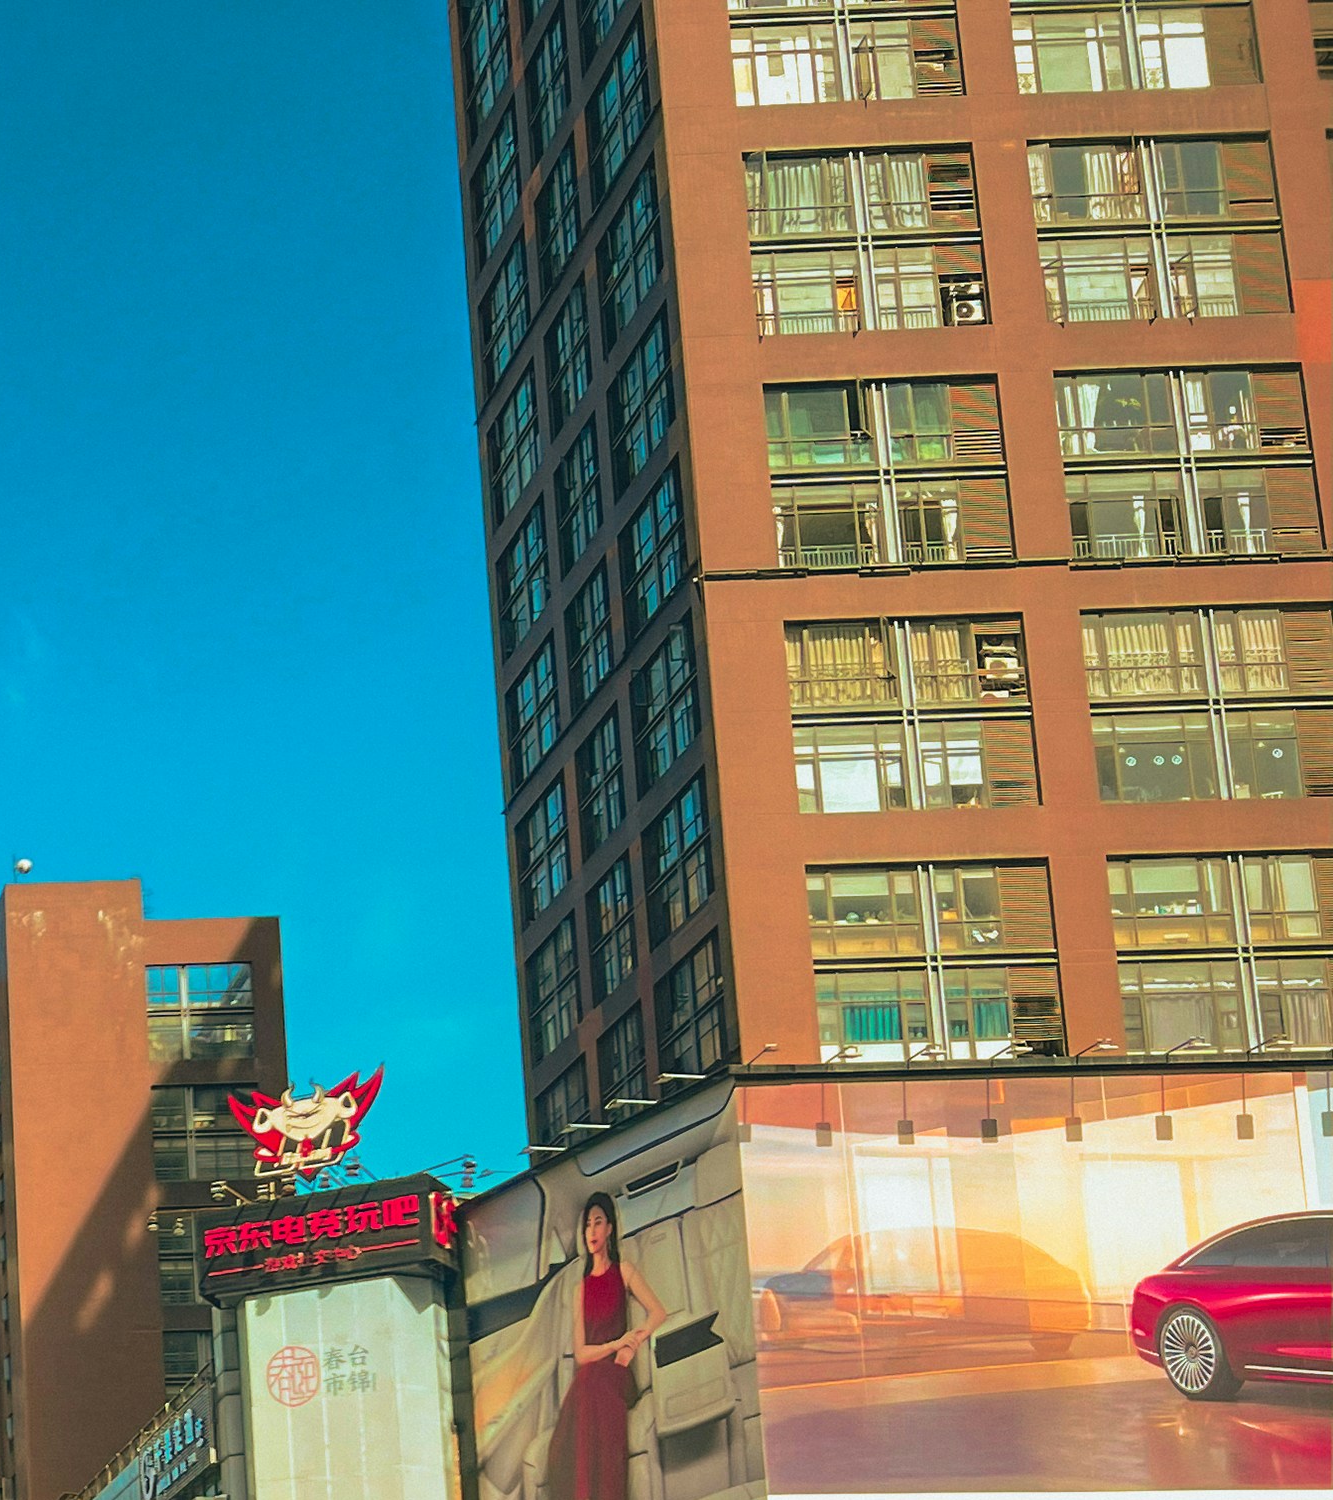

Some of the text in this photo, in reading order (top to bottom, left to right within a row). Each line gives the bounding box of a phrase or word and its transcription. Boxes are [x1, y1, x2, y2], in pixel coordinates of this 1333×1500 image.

[204, 1194, 420, 1258] 京东电竞玩吧
